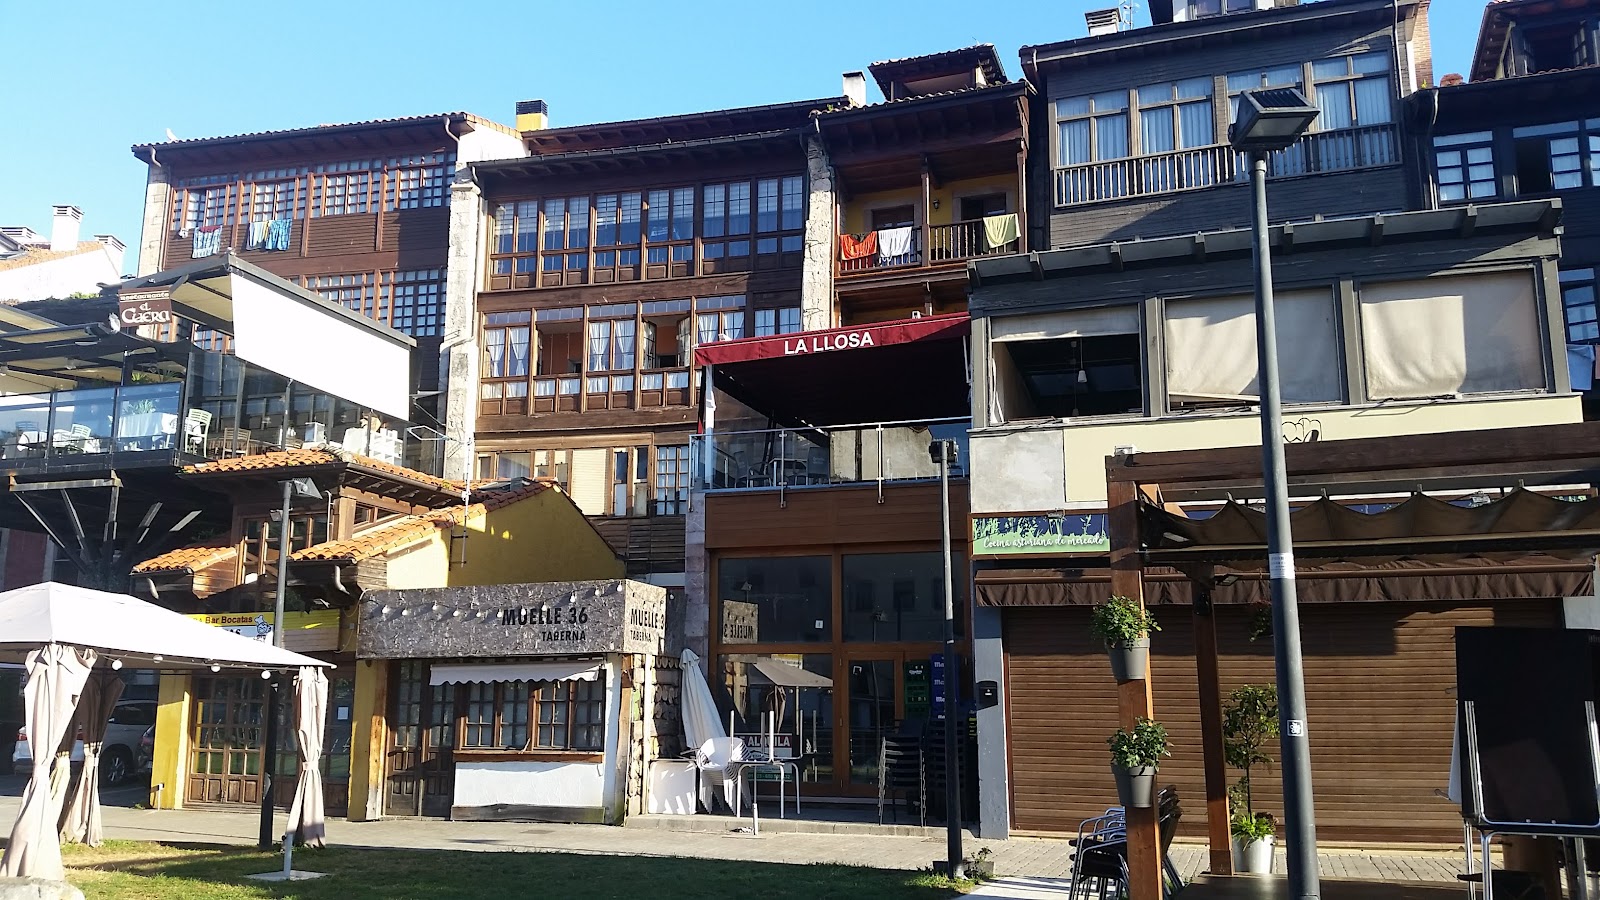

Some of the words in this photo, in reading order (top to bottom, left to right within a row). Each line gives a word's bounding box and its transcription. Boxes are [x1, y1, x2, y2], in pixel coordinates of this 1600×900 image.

[784, 339, 808, 354] LA
[813, 332, 874, 352] LLOSA
[983, 535, 1011, 548] Cocina
[1012, 537, 1054, 548] asturiana
[1054, 533, 1066, 546] de
[1067, 532, 1104, 546] mercado
[205, 616, 220, 624] Bar
[221, 615, 253, 624] Bocatas
[501, 607, 563, 626] MUELLE
[568, 606, 589, 624] 36
[630, 608, 658, 629] MUELLE
[541, 630, 586, 642] TABERNA
[630, 629, 652, 642] TABERNA
